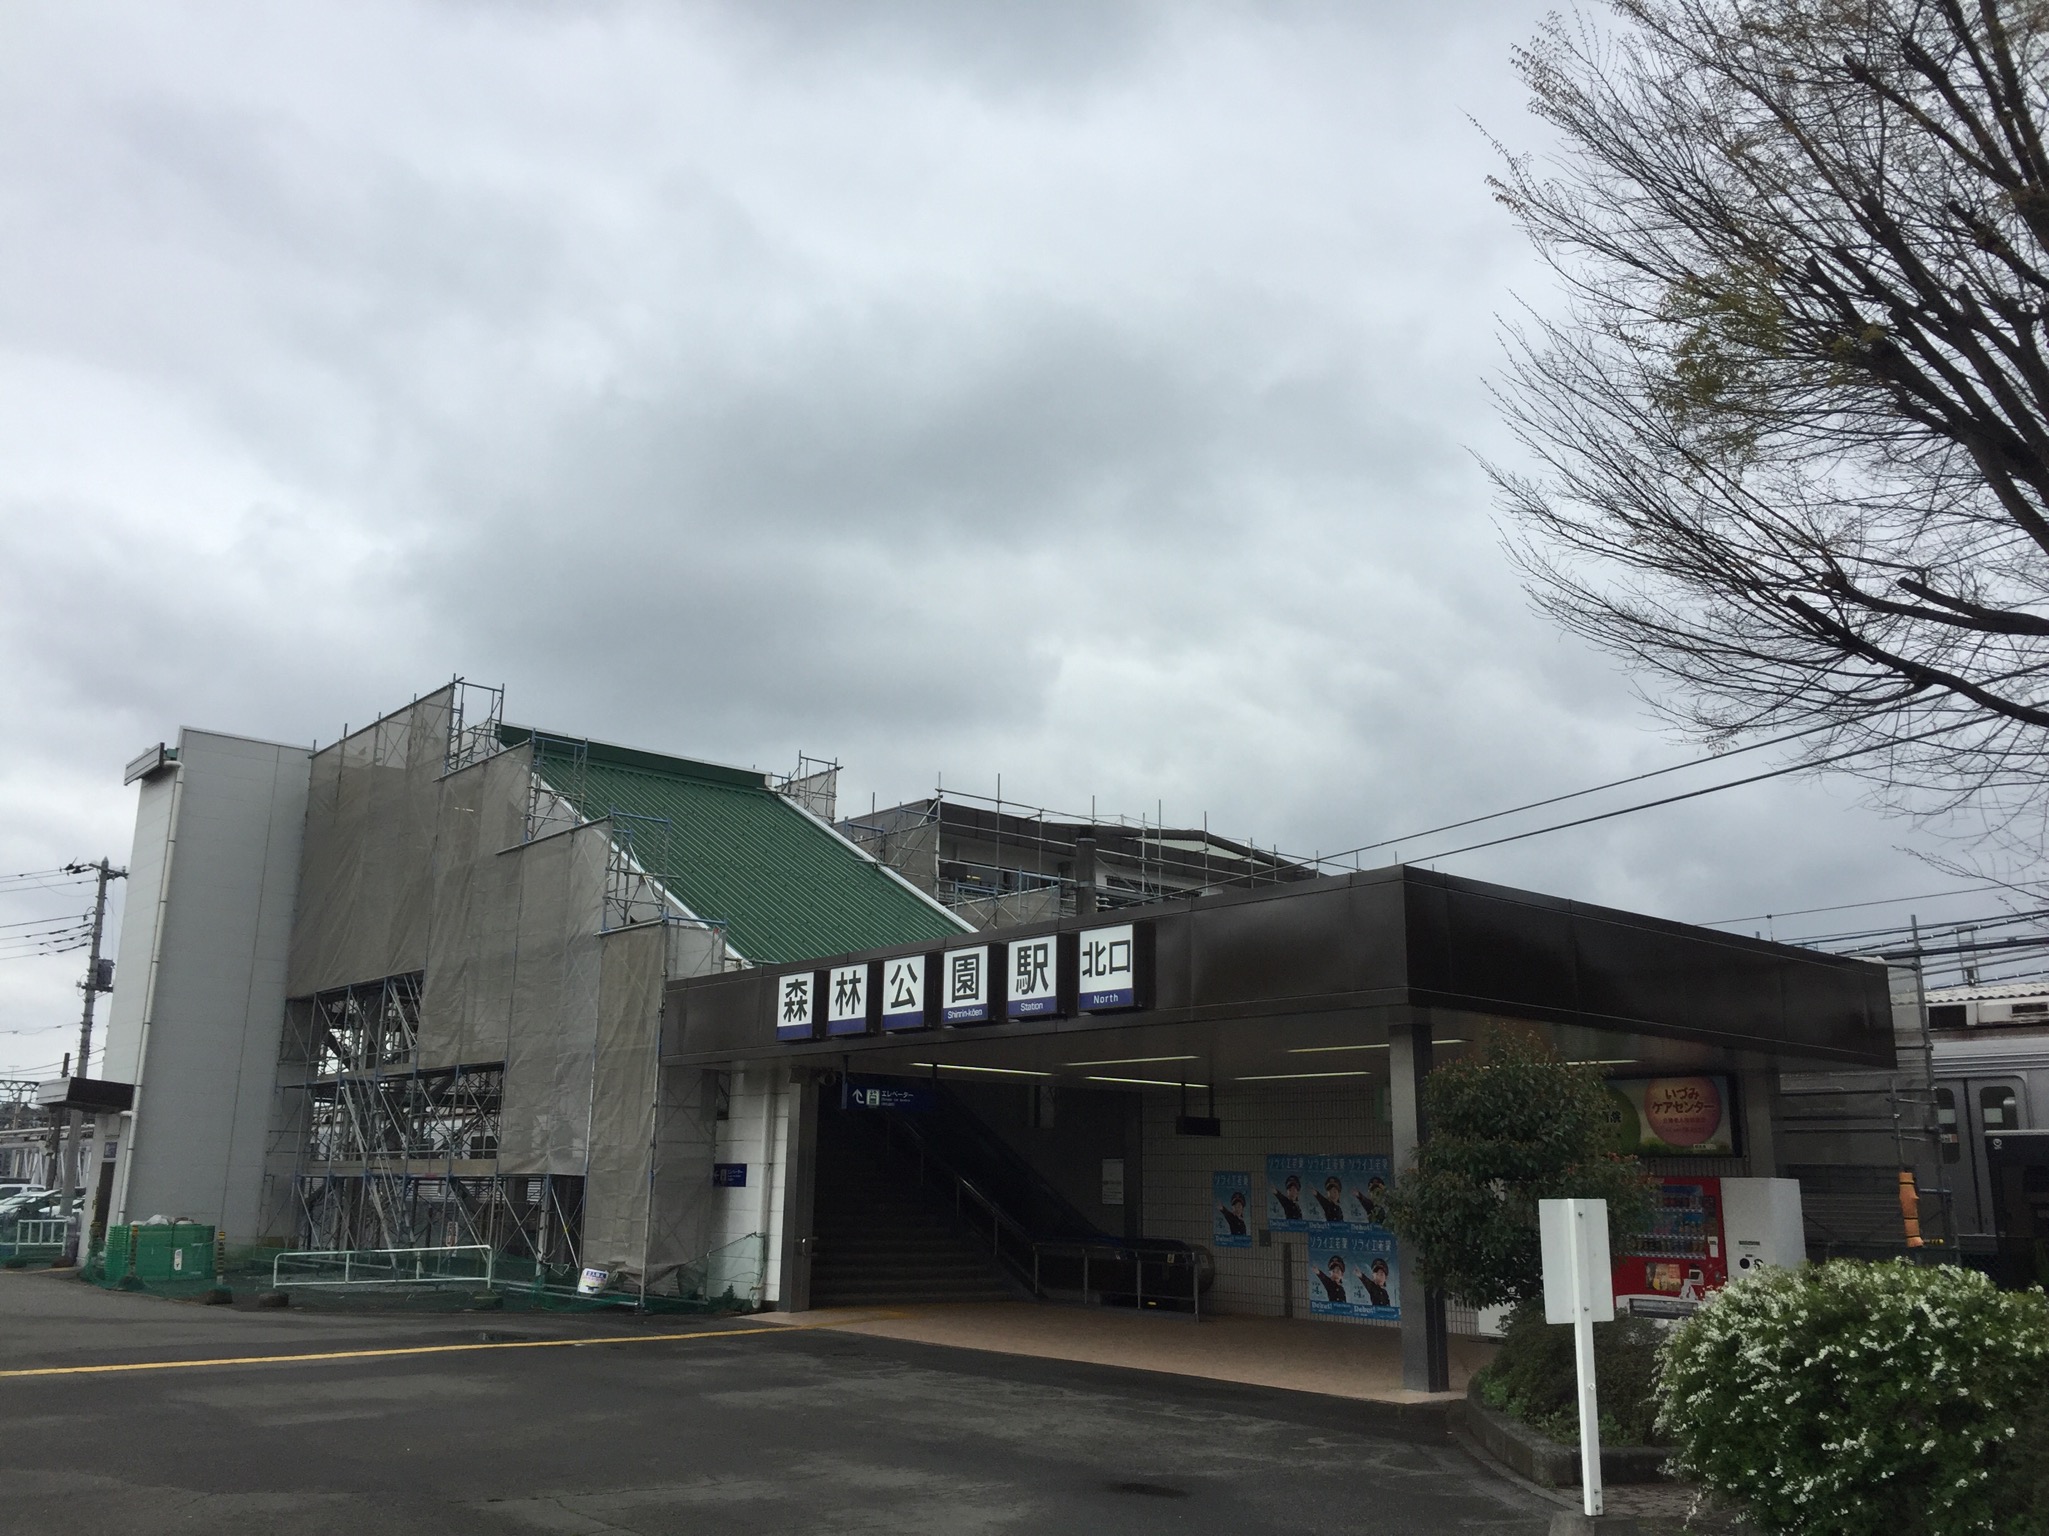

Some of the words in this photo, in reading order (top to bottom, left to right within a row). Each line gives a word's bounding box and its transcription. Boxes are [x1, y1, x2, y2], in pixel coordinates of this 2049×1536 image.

[1020, 1001, 1043, 1011] Station
[1093, 992, 1118, 1004] North
[881, 1090, 914, 1098] エレベーター
[1665, 1086, 1700, 1100] いづみ
[1652, 1101, 1715, 1114] ケアセンター
